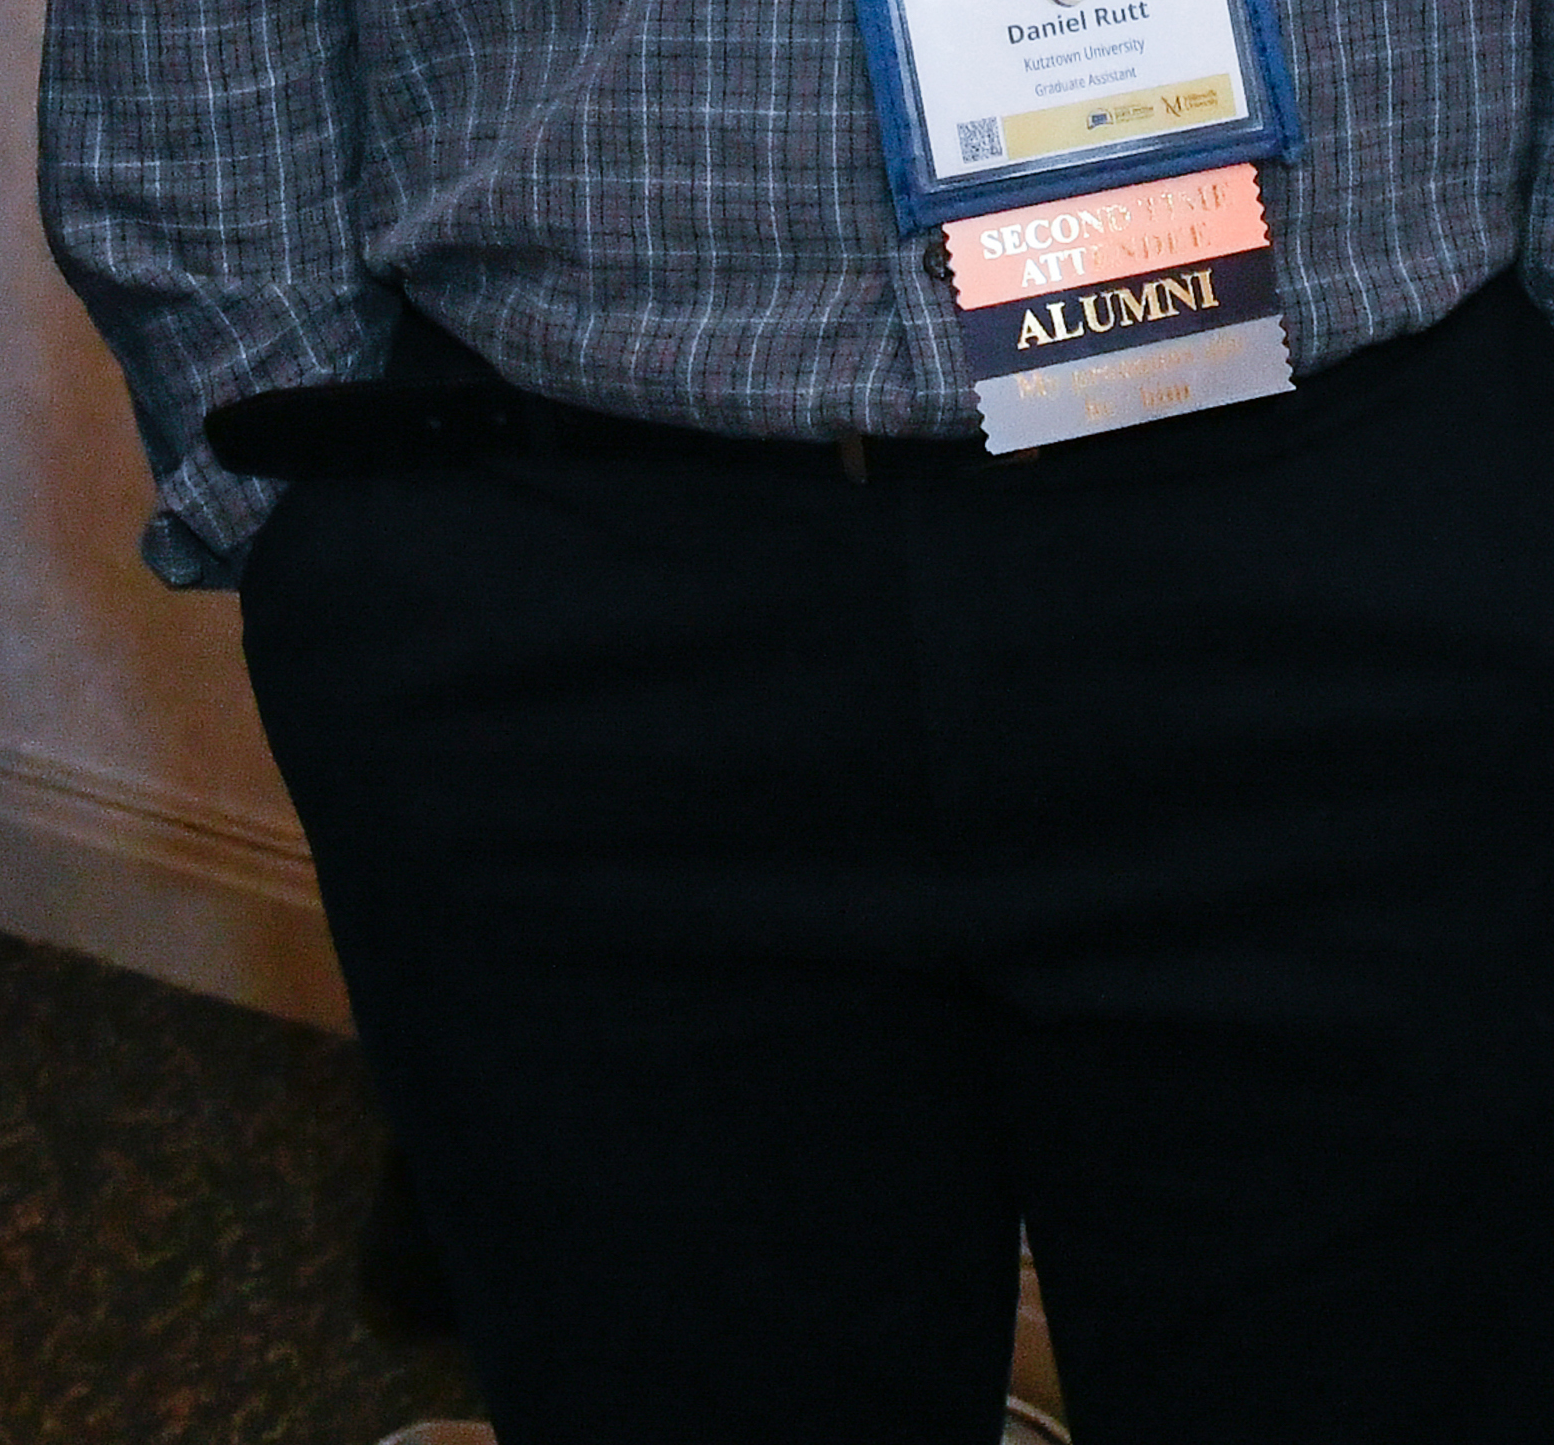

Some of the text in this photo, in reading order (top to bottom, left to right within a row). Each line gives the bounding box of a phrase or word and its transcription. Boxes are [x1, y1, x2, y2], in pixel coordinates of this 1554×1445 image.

[1008, 2, 1149, 44] Daniel Rutt
[1024, 39, 1144, 72] Kutztown University
[1035, 67, 1137, 97] Graduate Assistant
[1017, 269, 1219, 349] ALUMNI
